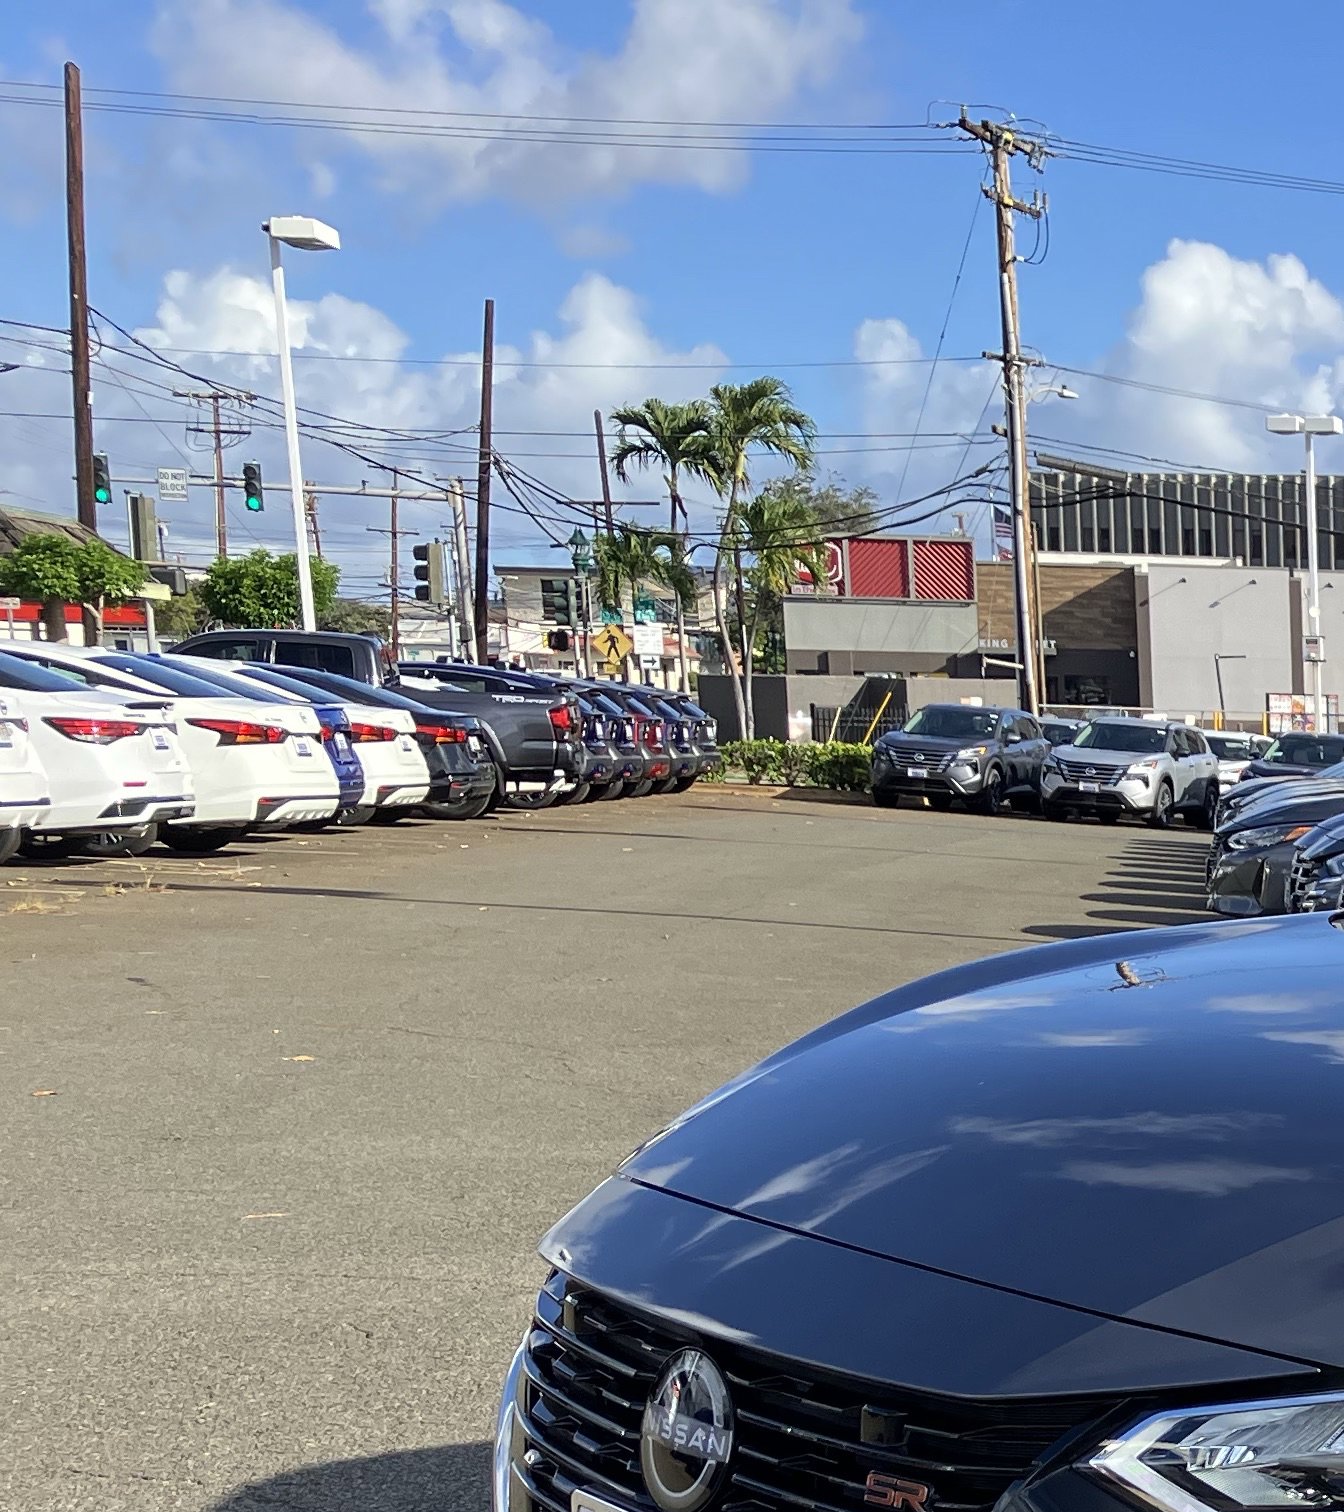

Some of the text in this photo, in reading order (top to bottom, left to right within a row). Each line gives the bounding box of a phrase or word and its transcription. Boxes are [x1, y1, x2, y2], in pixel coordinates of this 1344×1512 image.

[160, 471, 186, 481] DO NOT
[161, 482, 186, 491] BLOCK
[979, 638, 1008, 648] KING
